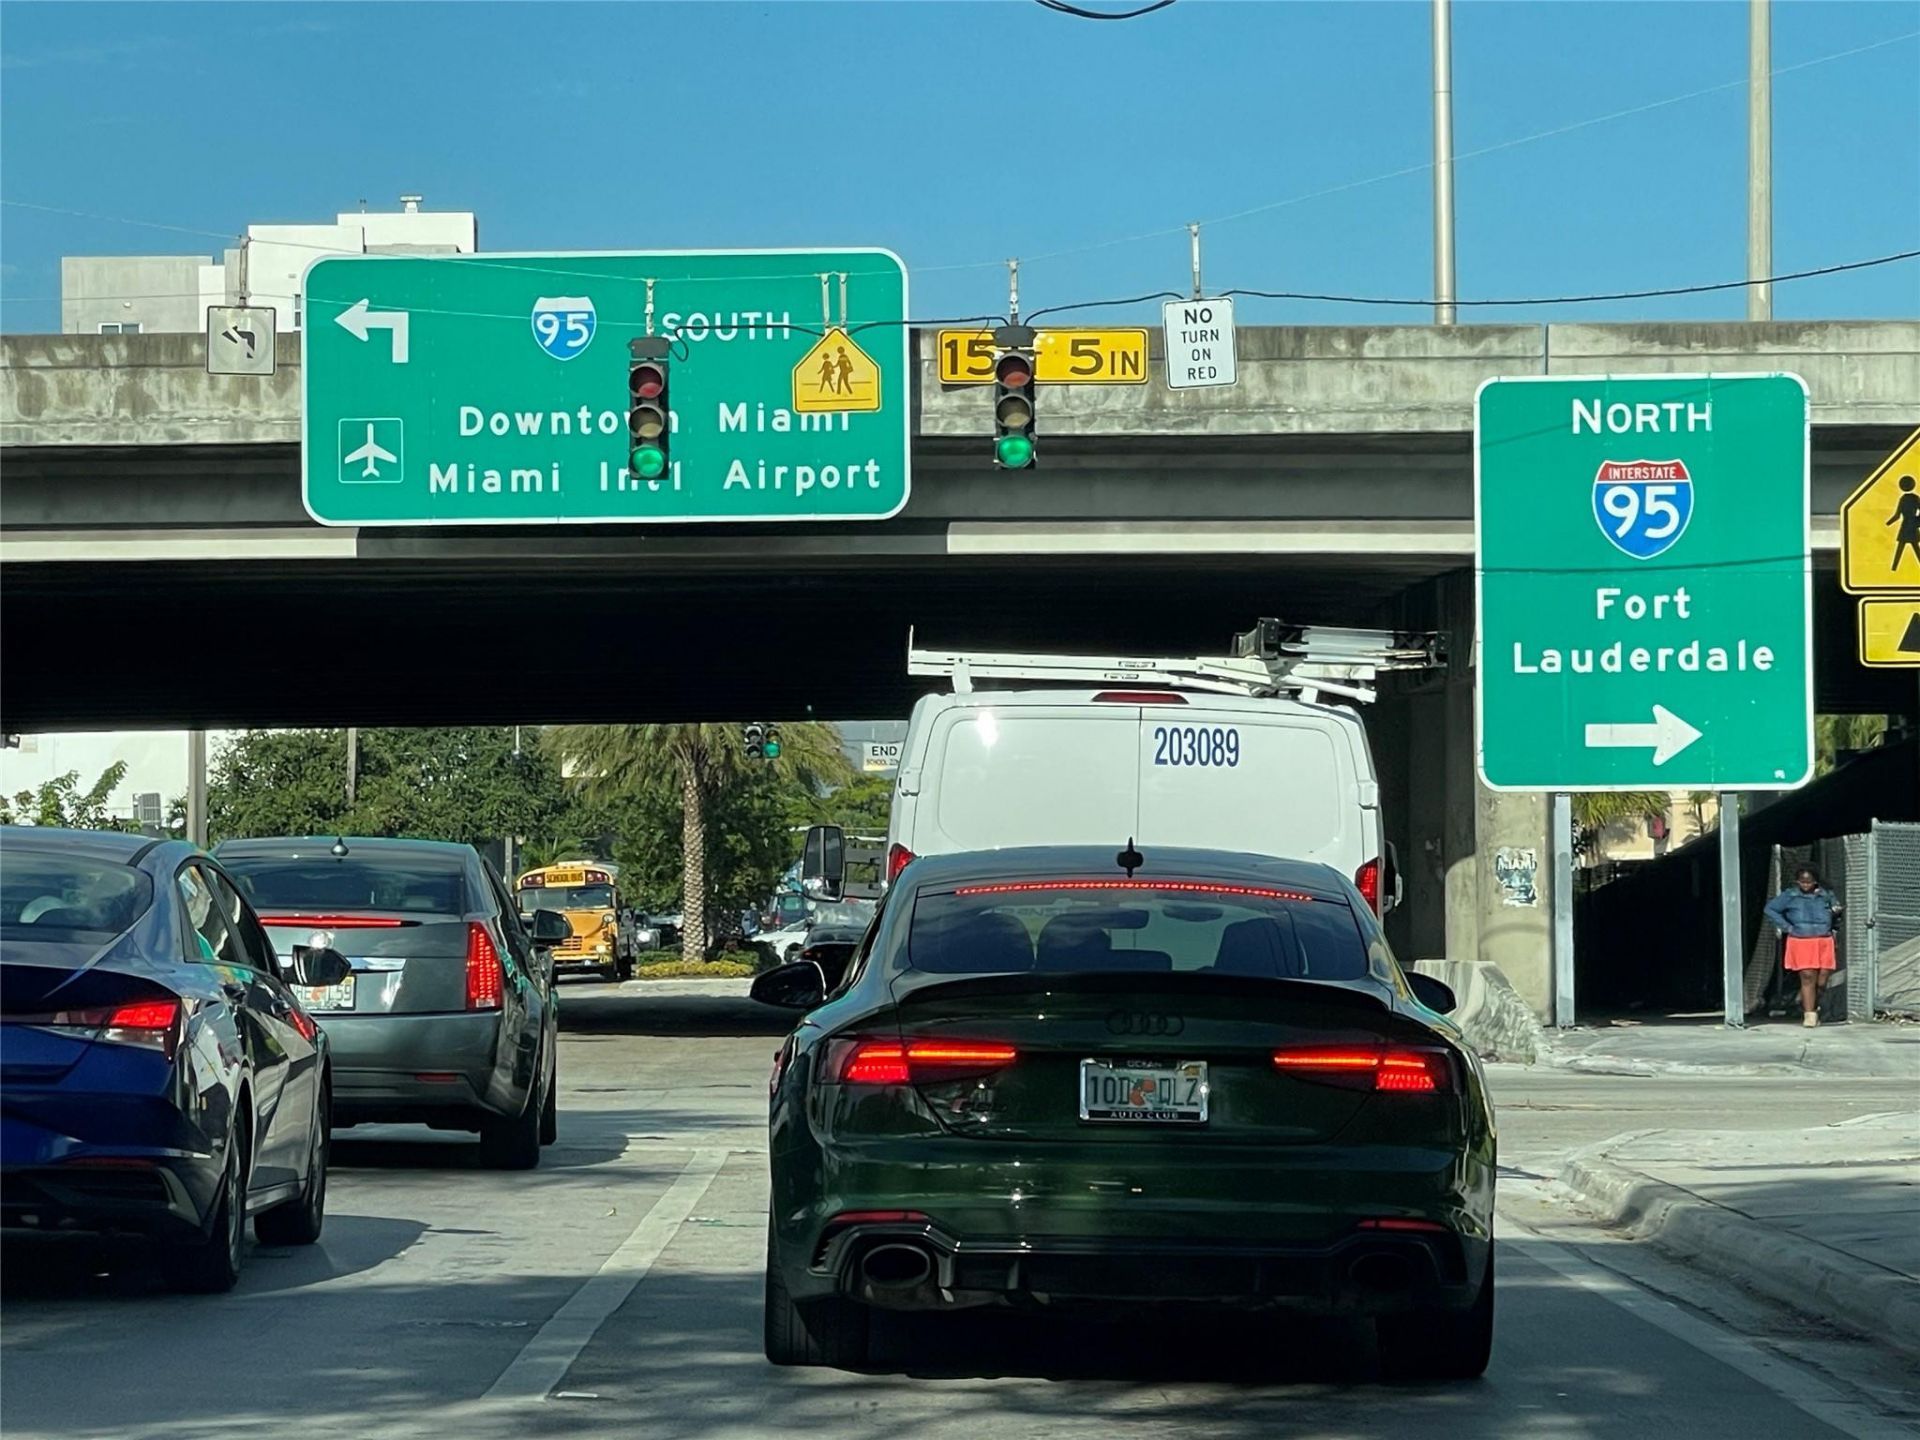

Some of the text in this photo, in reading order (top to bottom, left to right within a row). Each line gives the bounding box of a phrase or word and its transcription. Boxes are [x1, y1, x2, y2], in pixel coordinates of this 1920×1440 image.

[536, 311, 790, 347] 95 SOUTH
[1184, 307, 1213, 325] NO
[1180, 328, 1220, 344] TURN
[944, 339, 995, 376] 15
[1191, 348, 1212, 361] ON
[1187, 366, 1217, 380] RED
[459, 404, 679, 436] Downton
[1572, 398, 1713, 434] NORTH
[430, 461, 560, 493] Miami
[723, 458, 881, 497] Airport
[1608, 466, 1677, 480] INTERSTATE
[1603, 485, 1681, 539] 95
[1596, 586, 1691, 620] Fort
[1513, 639, 1775, 673] Lauderdale
[871, 745, 898, 757] END
[1154, 727, 1240, 768] 203089
[1110, 1110, 1179, 1120] AUTO CLUB
